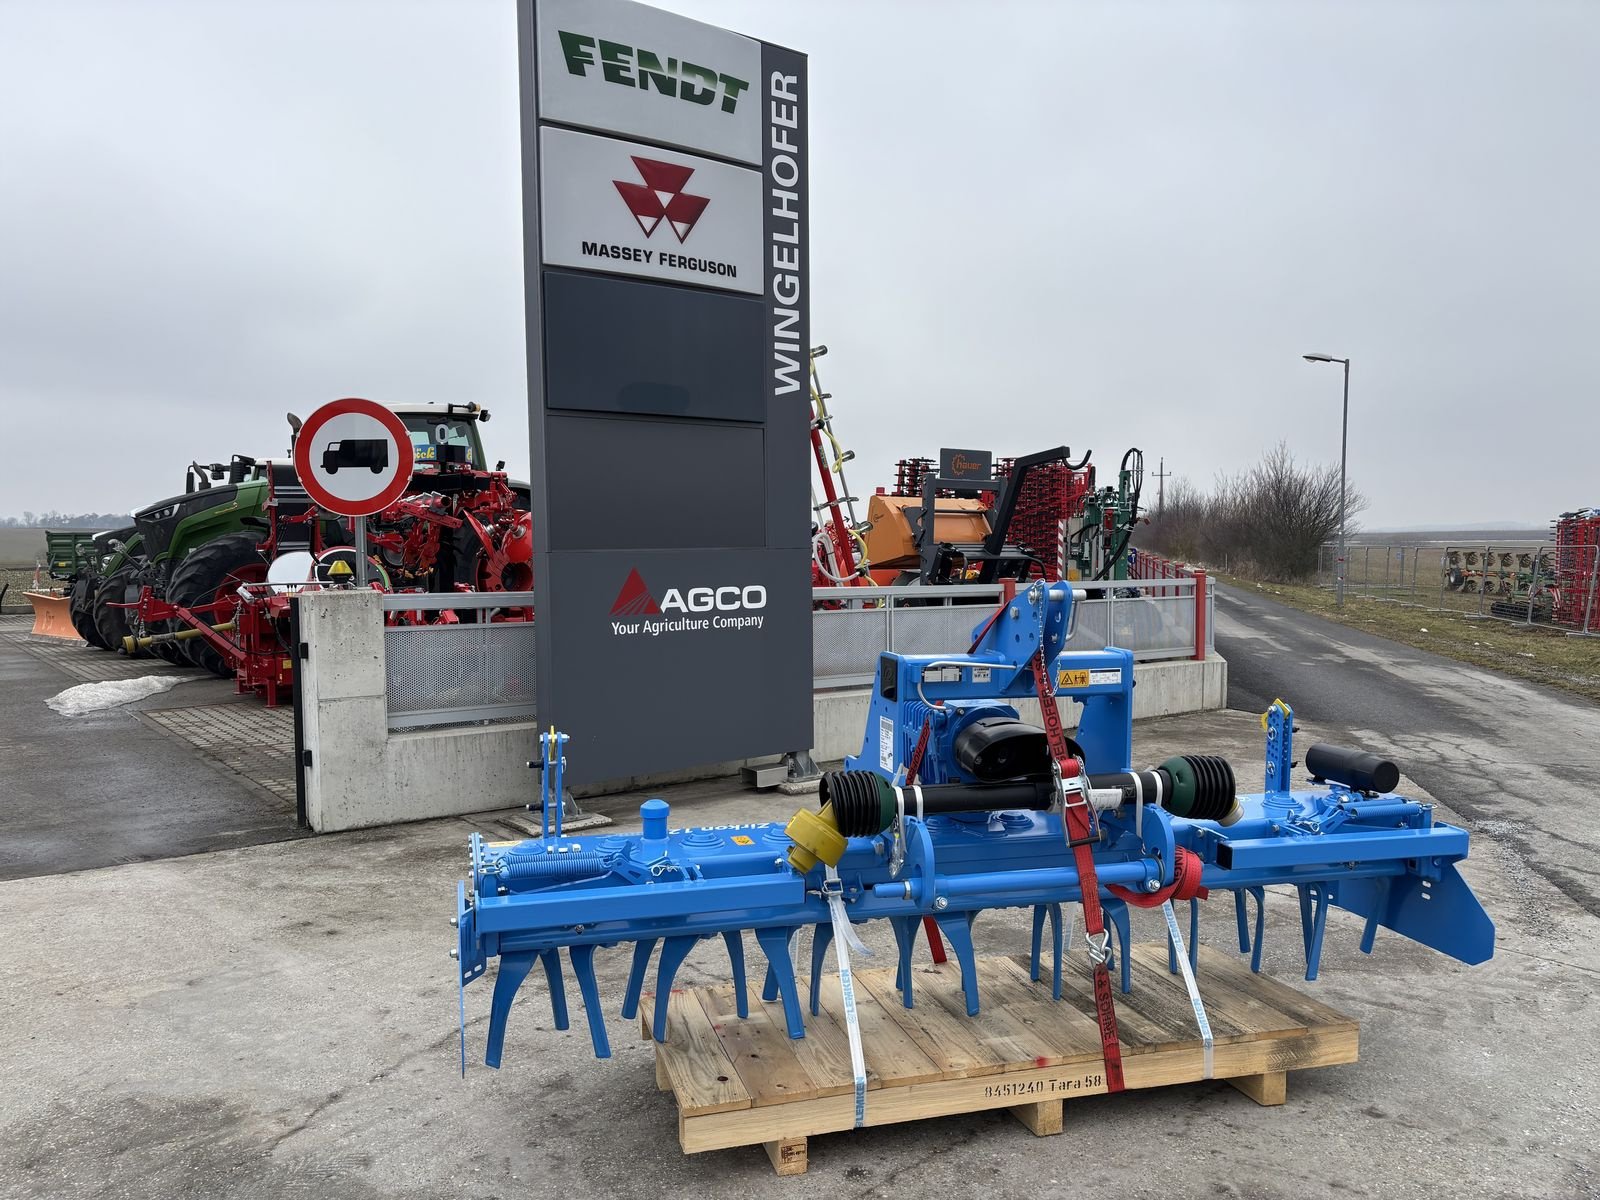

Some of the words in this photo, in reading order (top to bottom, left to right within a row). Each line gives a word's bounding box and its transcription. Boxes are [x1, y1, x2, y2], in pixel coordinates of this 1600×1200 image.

[558, 30, 749, 114] FENDT
[771, 71, 800, 396] WINGELHOFER
[582, 241, 653, 264] MASSEY
[659, 253, 737, 278] FERGUSON
[660, 585, 767, 614] AGCO
[611, 621, 640, 635] Your
[642, 617, 710, 636] Agriculture
[712, 615, 764, 630] Company
[701, 822, 770, 831] Zirkon
[1164, 903, 1182, 946] LEMKEN
[841, 969, 855, 1014] LEMKEN
[855, 1076, 865, 1121] LEMKEN
[985, 1081, 1044, 1097] 8451240
[1049, 1079, 1081, 1091] Tara
[1085, 1075, 1101, 1087] 58
